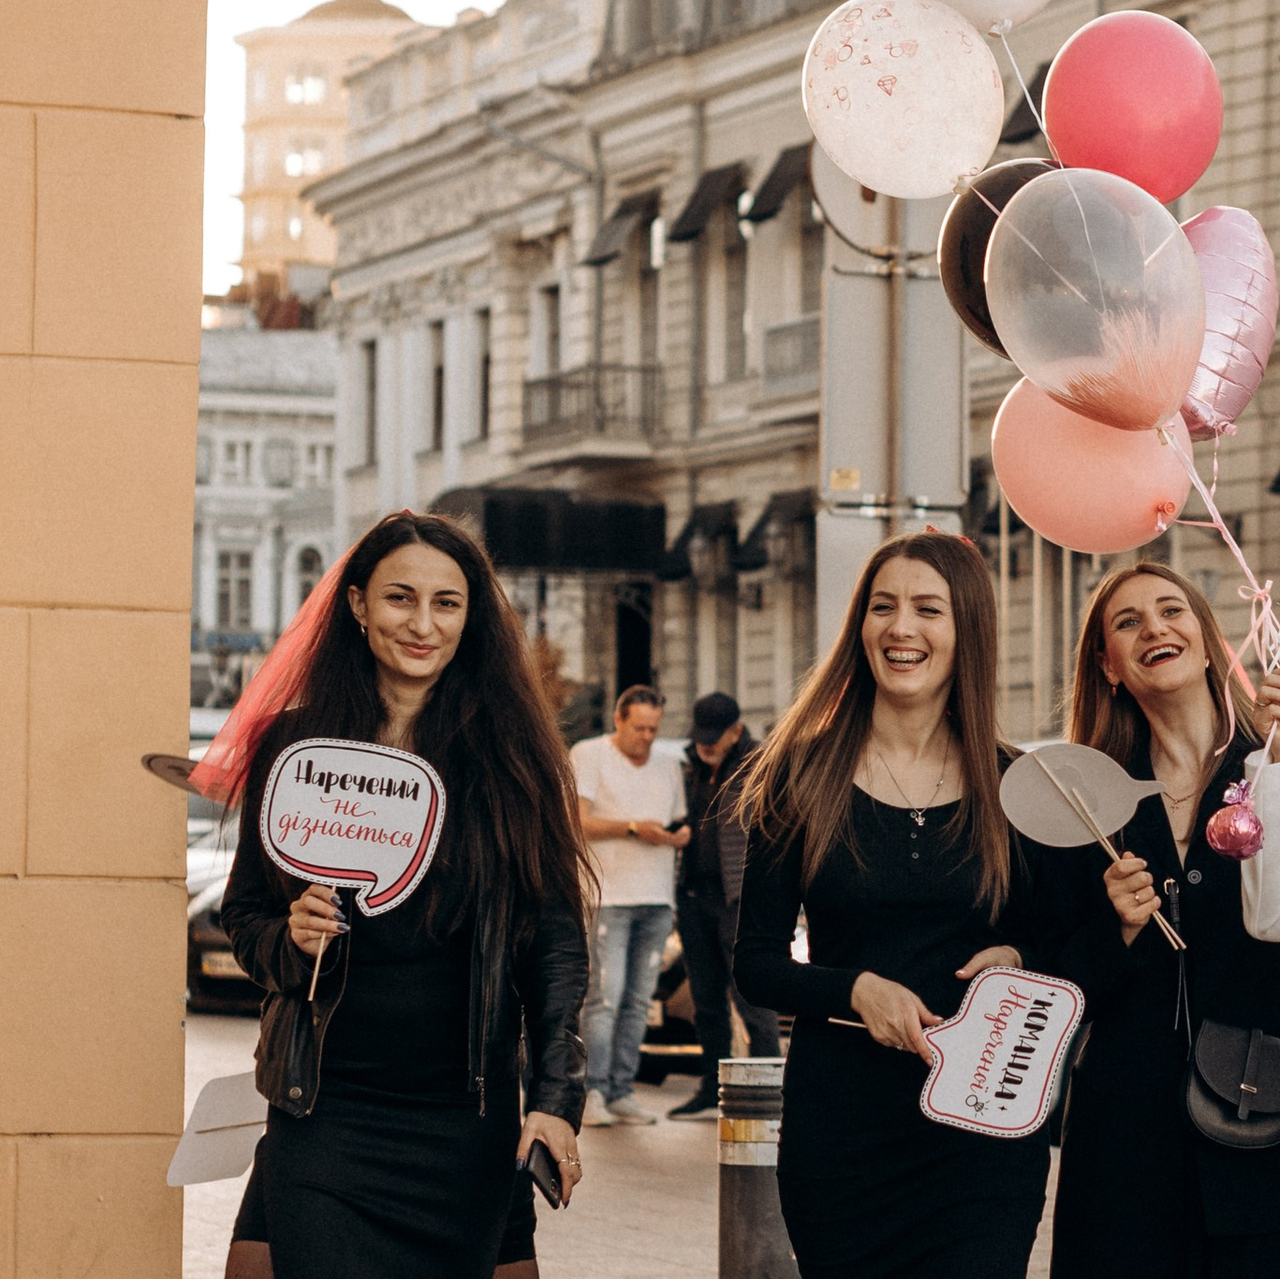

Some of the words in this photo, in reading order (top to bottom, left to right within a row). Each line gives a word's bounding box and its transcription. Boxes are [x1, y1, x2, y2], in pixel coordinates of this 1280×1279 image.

[294, 759, 420, 802] Наречений
[320, 796, 377, 818] не
[278, 811, 418, 849] дізнається
[969, 984, 1033, 1094] Нареченої
[994, 998, 1053, 1100] КОМАНДА
